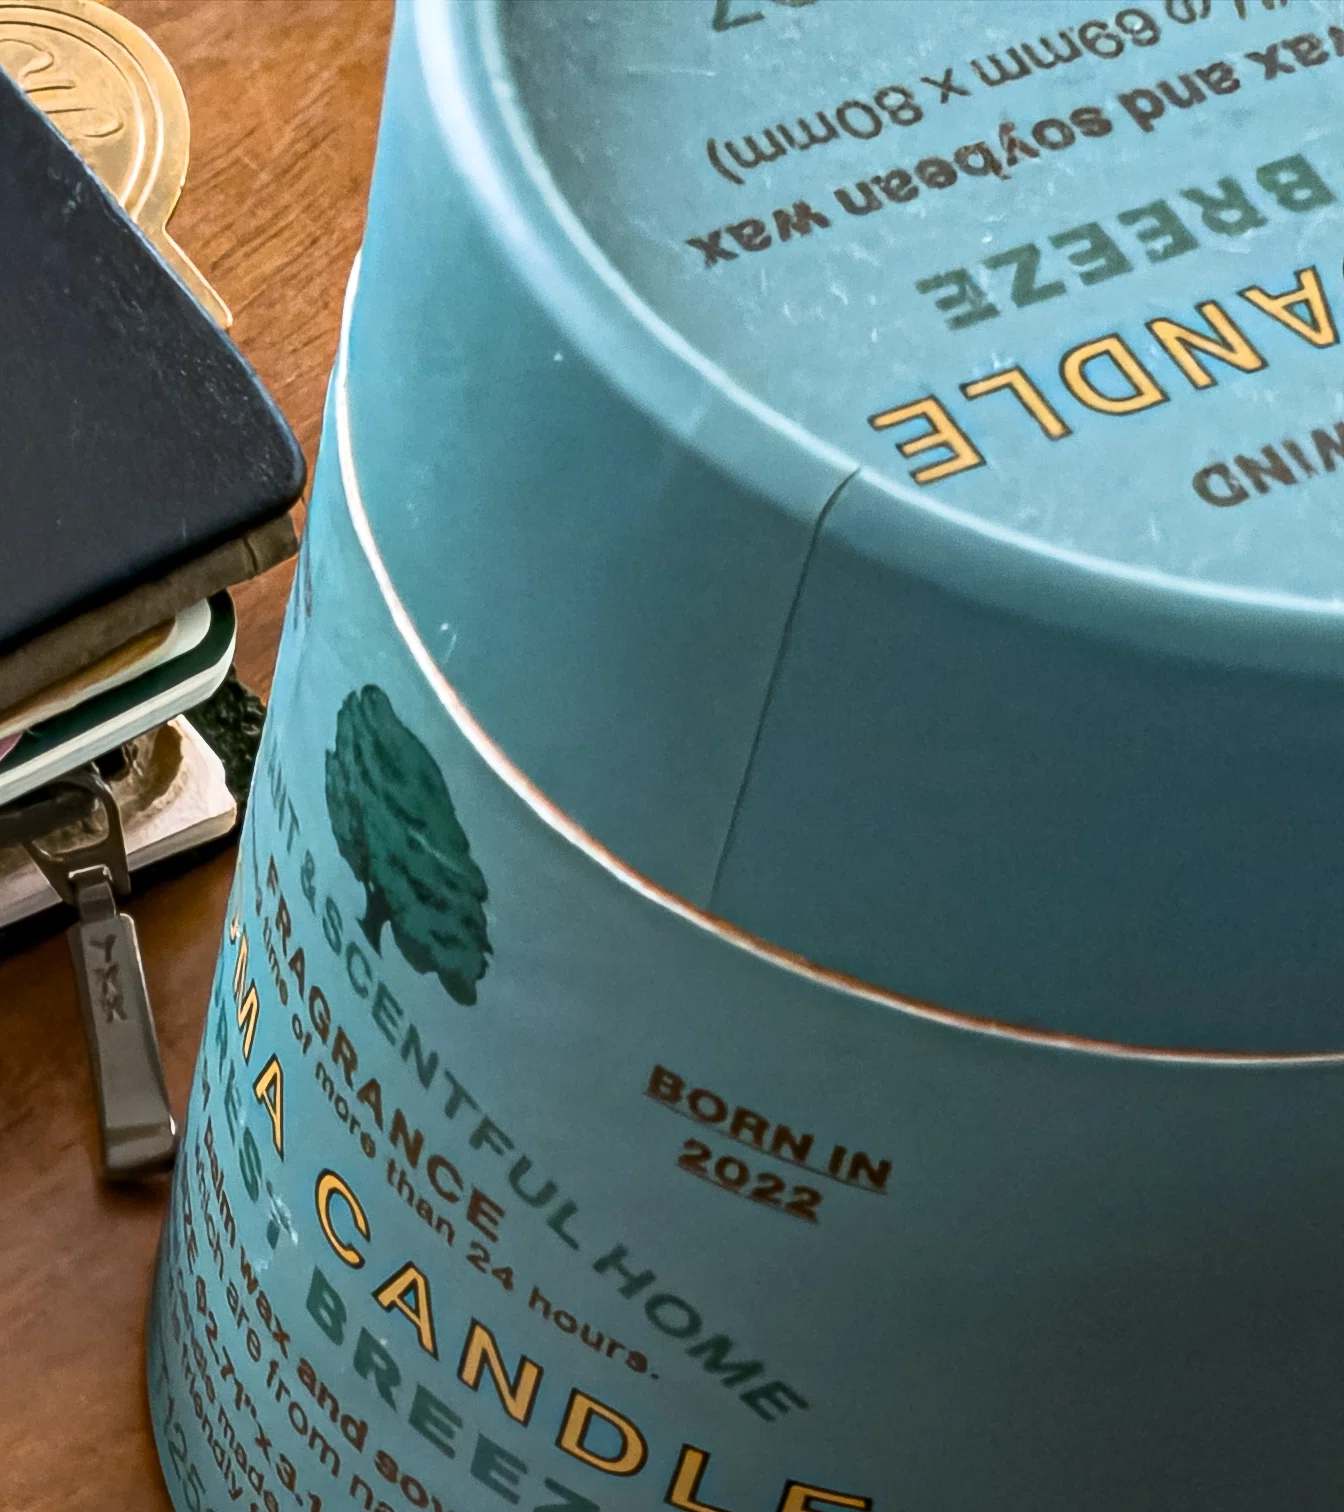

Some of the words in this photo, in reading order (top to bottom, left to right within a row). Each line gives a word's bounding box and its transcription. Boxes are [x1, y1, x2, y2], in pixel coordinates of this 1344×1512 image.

[706, 86, 924, 185] 80mm)
[834, 106, 1112, 217] soybean
[921, 69, 971, 104] x
[1118, 62, 1241, 133] and
[686, 200, 831, 268] wax
[915, 153, 1337, 331] BREEZE
[867, 265, 1344, 485] ANDLE
[266, 854, 505, 1242] FRAGRANCE
[292, 1013, 311, 1055] of
[315, 1061, 376, 1158] more
[386, 1157, 455, 1246] than
[465, 1241, 514, 1291] 24
[527, 1286, 660, 1380] hours.
[322, 895, 582, 1251] SCENTFUL
[592, 1242, 811, 1423] HOME
[646, 1064, 817, 1164] BORN
[828, 1144, 894, 1192] IN
[677, 1138, 825, 1225] 2022
[226, 1279, 261, 1363] are
[266, 1359, 340, 1477] from
[240, 1245, 291, 1358] wax
[296, 1356, 368, 1453] and
